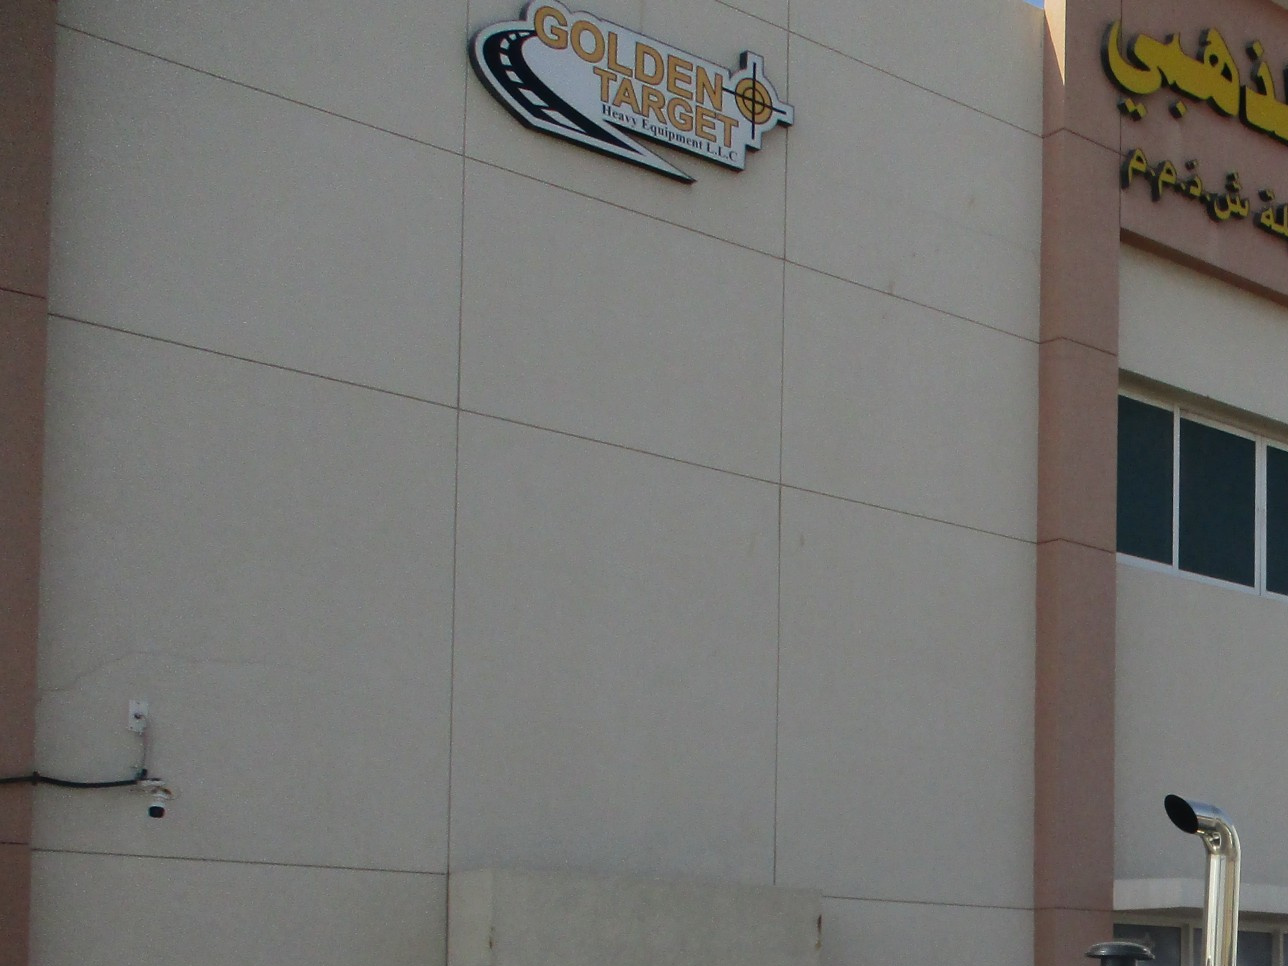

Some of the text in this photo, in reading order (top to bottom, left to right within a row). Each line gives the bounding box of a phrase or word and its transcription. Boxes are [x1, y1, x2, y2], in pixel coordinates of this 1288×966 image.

[534, 6, 723, 112] GOLDEN
[593, 66, 739, 148] TARGET
[602, 104, 637, 128] Heavy
[642, 119, 702, 150] Equipment
